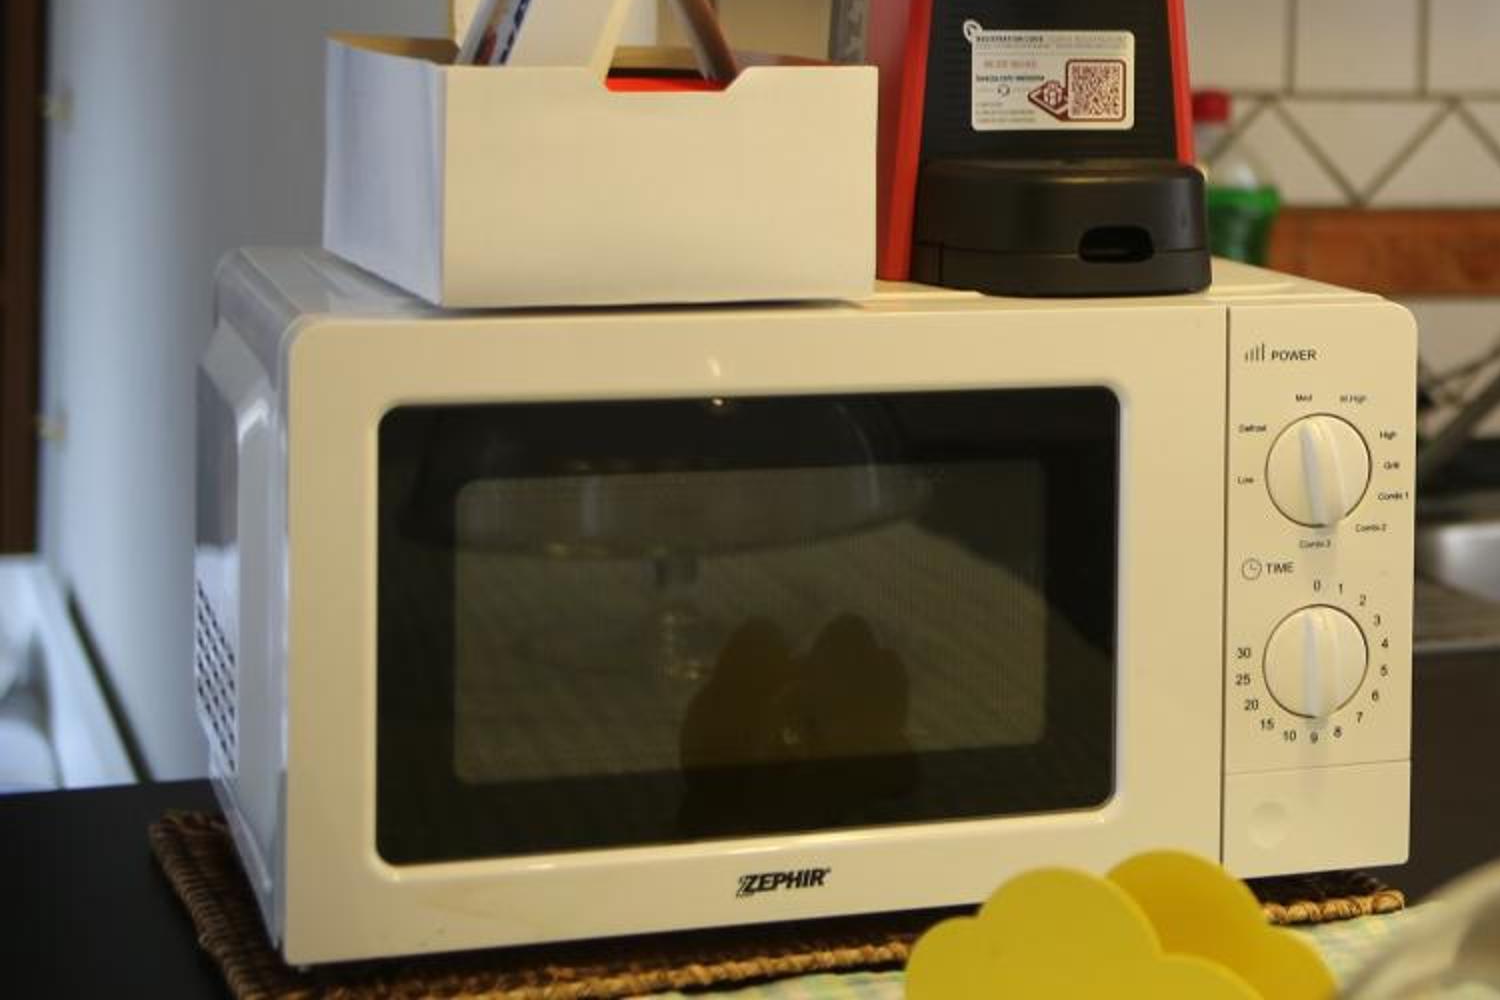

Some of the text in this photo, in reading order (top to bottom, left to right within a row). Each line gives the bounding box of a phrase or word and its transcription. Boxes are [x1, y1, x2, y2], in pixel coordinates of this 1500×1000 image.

[1271, 349, 1317, 361] POWER
[1295, 394, 1313, 402] Med
[1379, 431, 1398, 440] High
[1383, 461, 1400, 470] Grill
[1237, 476, 1255, 485] Low
[1266, 561, 1294, 574] TIME
[1313, 579, 1321, 592] 0
[1359, 594, 1367, 607] 2
[1373, 614, 1381, 626] 3
[1381, 637, 1389, 649] 4
[1237, 647, 1252, 660] 30
[1380, 664, 1389, 677] 5
[1235, 673, 1252, 687] 25
[1371, 690, 1380, 702] 6
[1244, 698, 1260, 712] 20
[1260, 717, 1275, 731] 15
[1356, 711, 1365, 724] 7
[1283, 729, 1297, 742] 10
[1309, 731, 1319, 744] 9
[1333, 726, 1342, 739] 8
[738, 867, 830, 896] ZEPHIR
